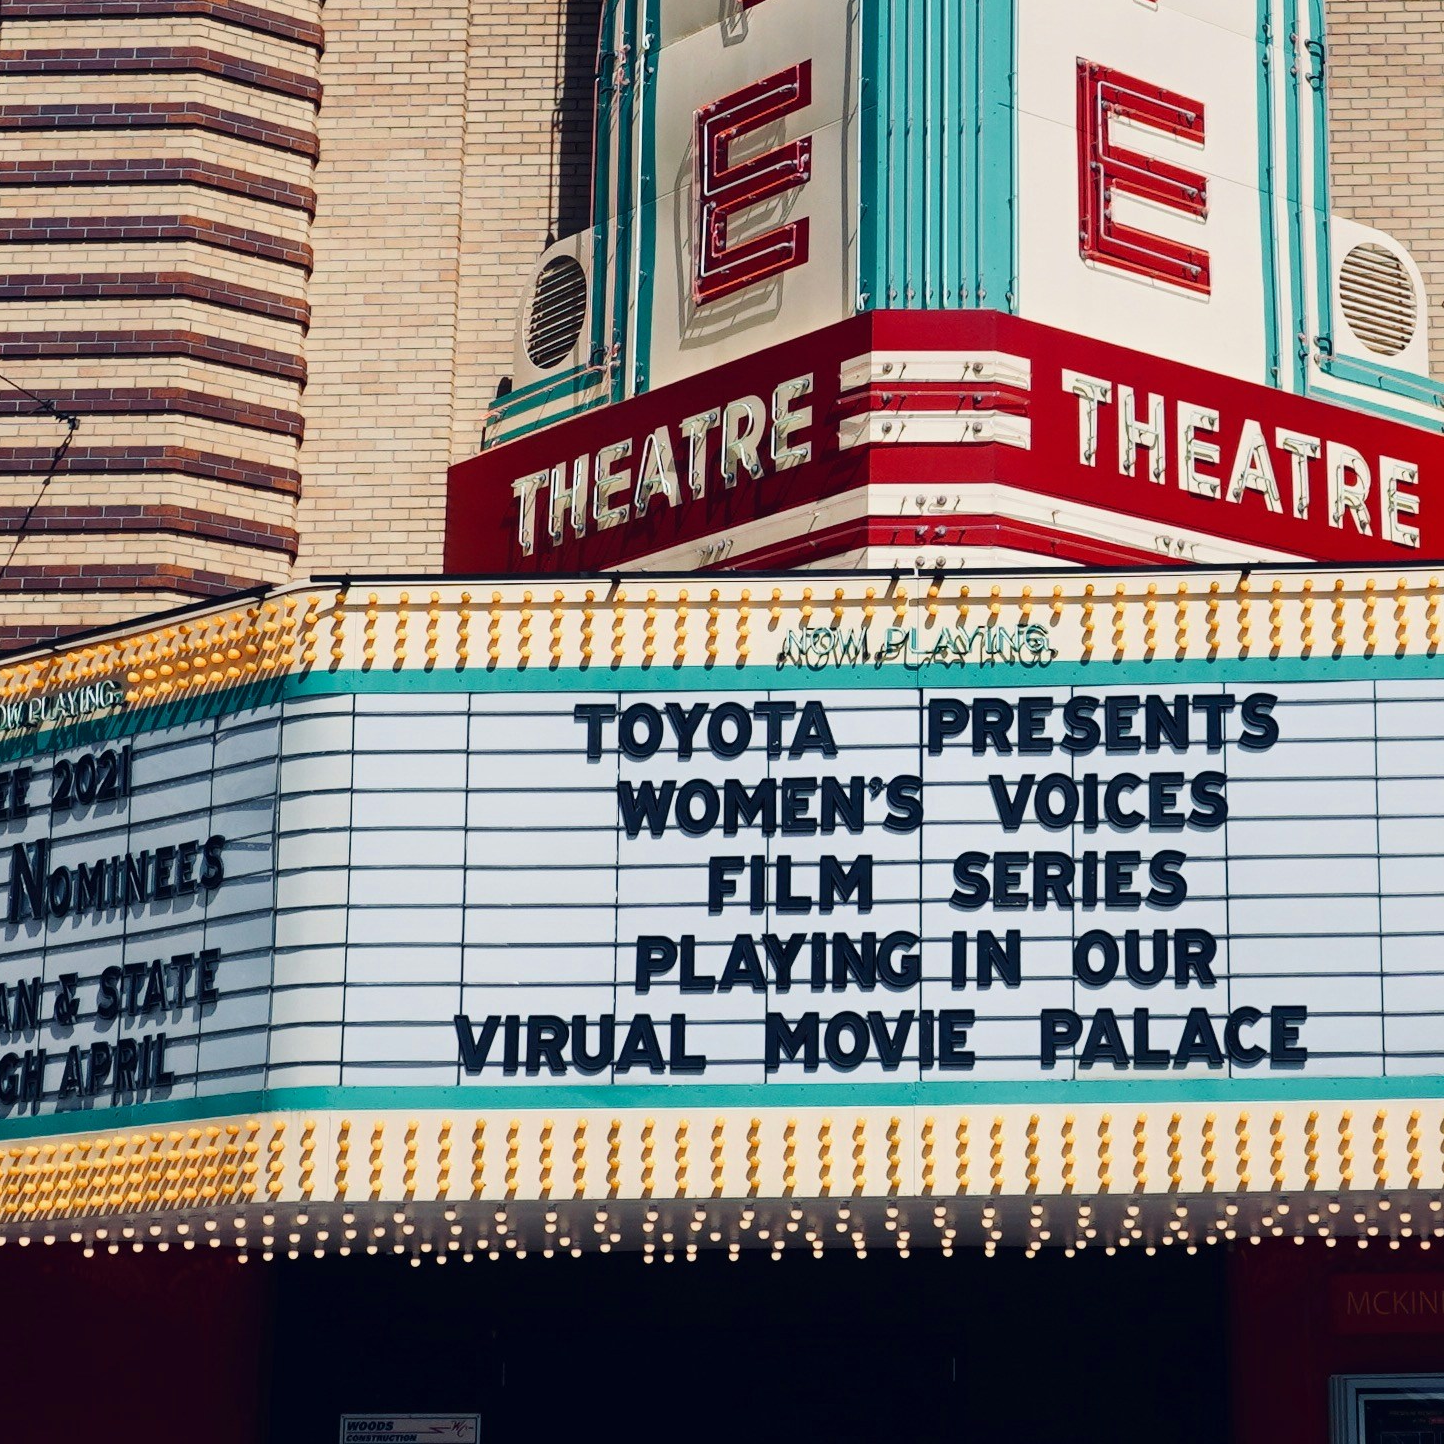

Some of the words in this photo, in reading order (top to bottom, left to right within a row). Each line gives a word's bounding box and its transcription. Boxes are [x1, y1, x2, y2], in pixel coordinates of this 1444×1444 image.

[511, 371, 815, 557] THEATRE
[1060, 368, 1421, 550] THEATRE
[785, 626, 867, 656] NOW
[884, 623, 1049, 655] PLAYING
[29, 680, 123, 722] PLAYING
[575, 700, 837, 762] TOYOTA
[928, 693, 1278, 755] PRESENTS
[53, 745, 131, 810] 2021
[618, 774, 923, 838] WOMEN'S
[989, 771, 1228, 833] VOICES
[709, 854, 873, 915] FILM
[950, 850, 1186, 911] SERIES
[54, 973, 78, 1025] &
[97, 949, 221, 1021] STATE
[635, 930, 921, 994] PLAYING
[952, 930, 1021, 988] IN
[1075, 929, 1216, 987] OUR
[58, 1033, 174, 1098] APRIL
[454, 1014, 705, 1077] VIRUAL
[765, 1009, 974, 1073] MOVIE
[1040, 1005, 1308, 1069] PALACE
[346, 1434, 417, 1442] CONSTRUCTION
[347, 1421, 393, 1431] WOODS
